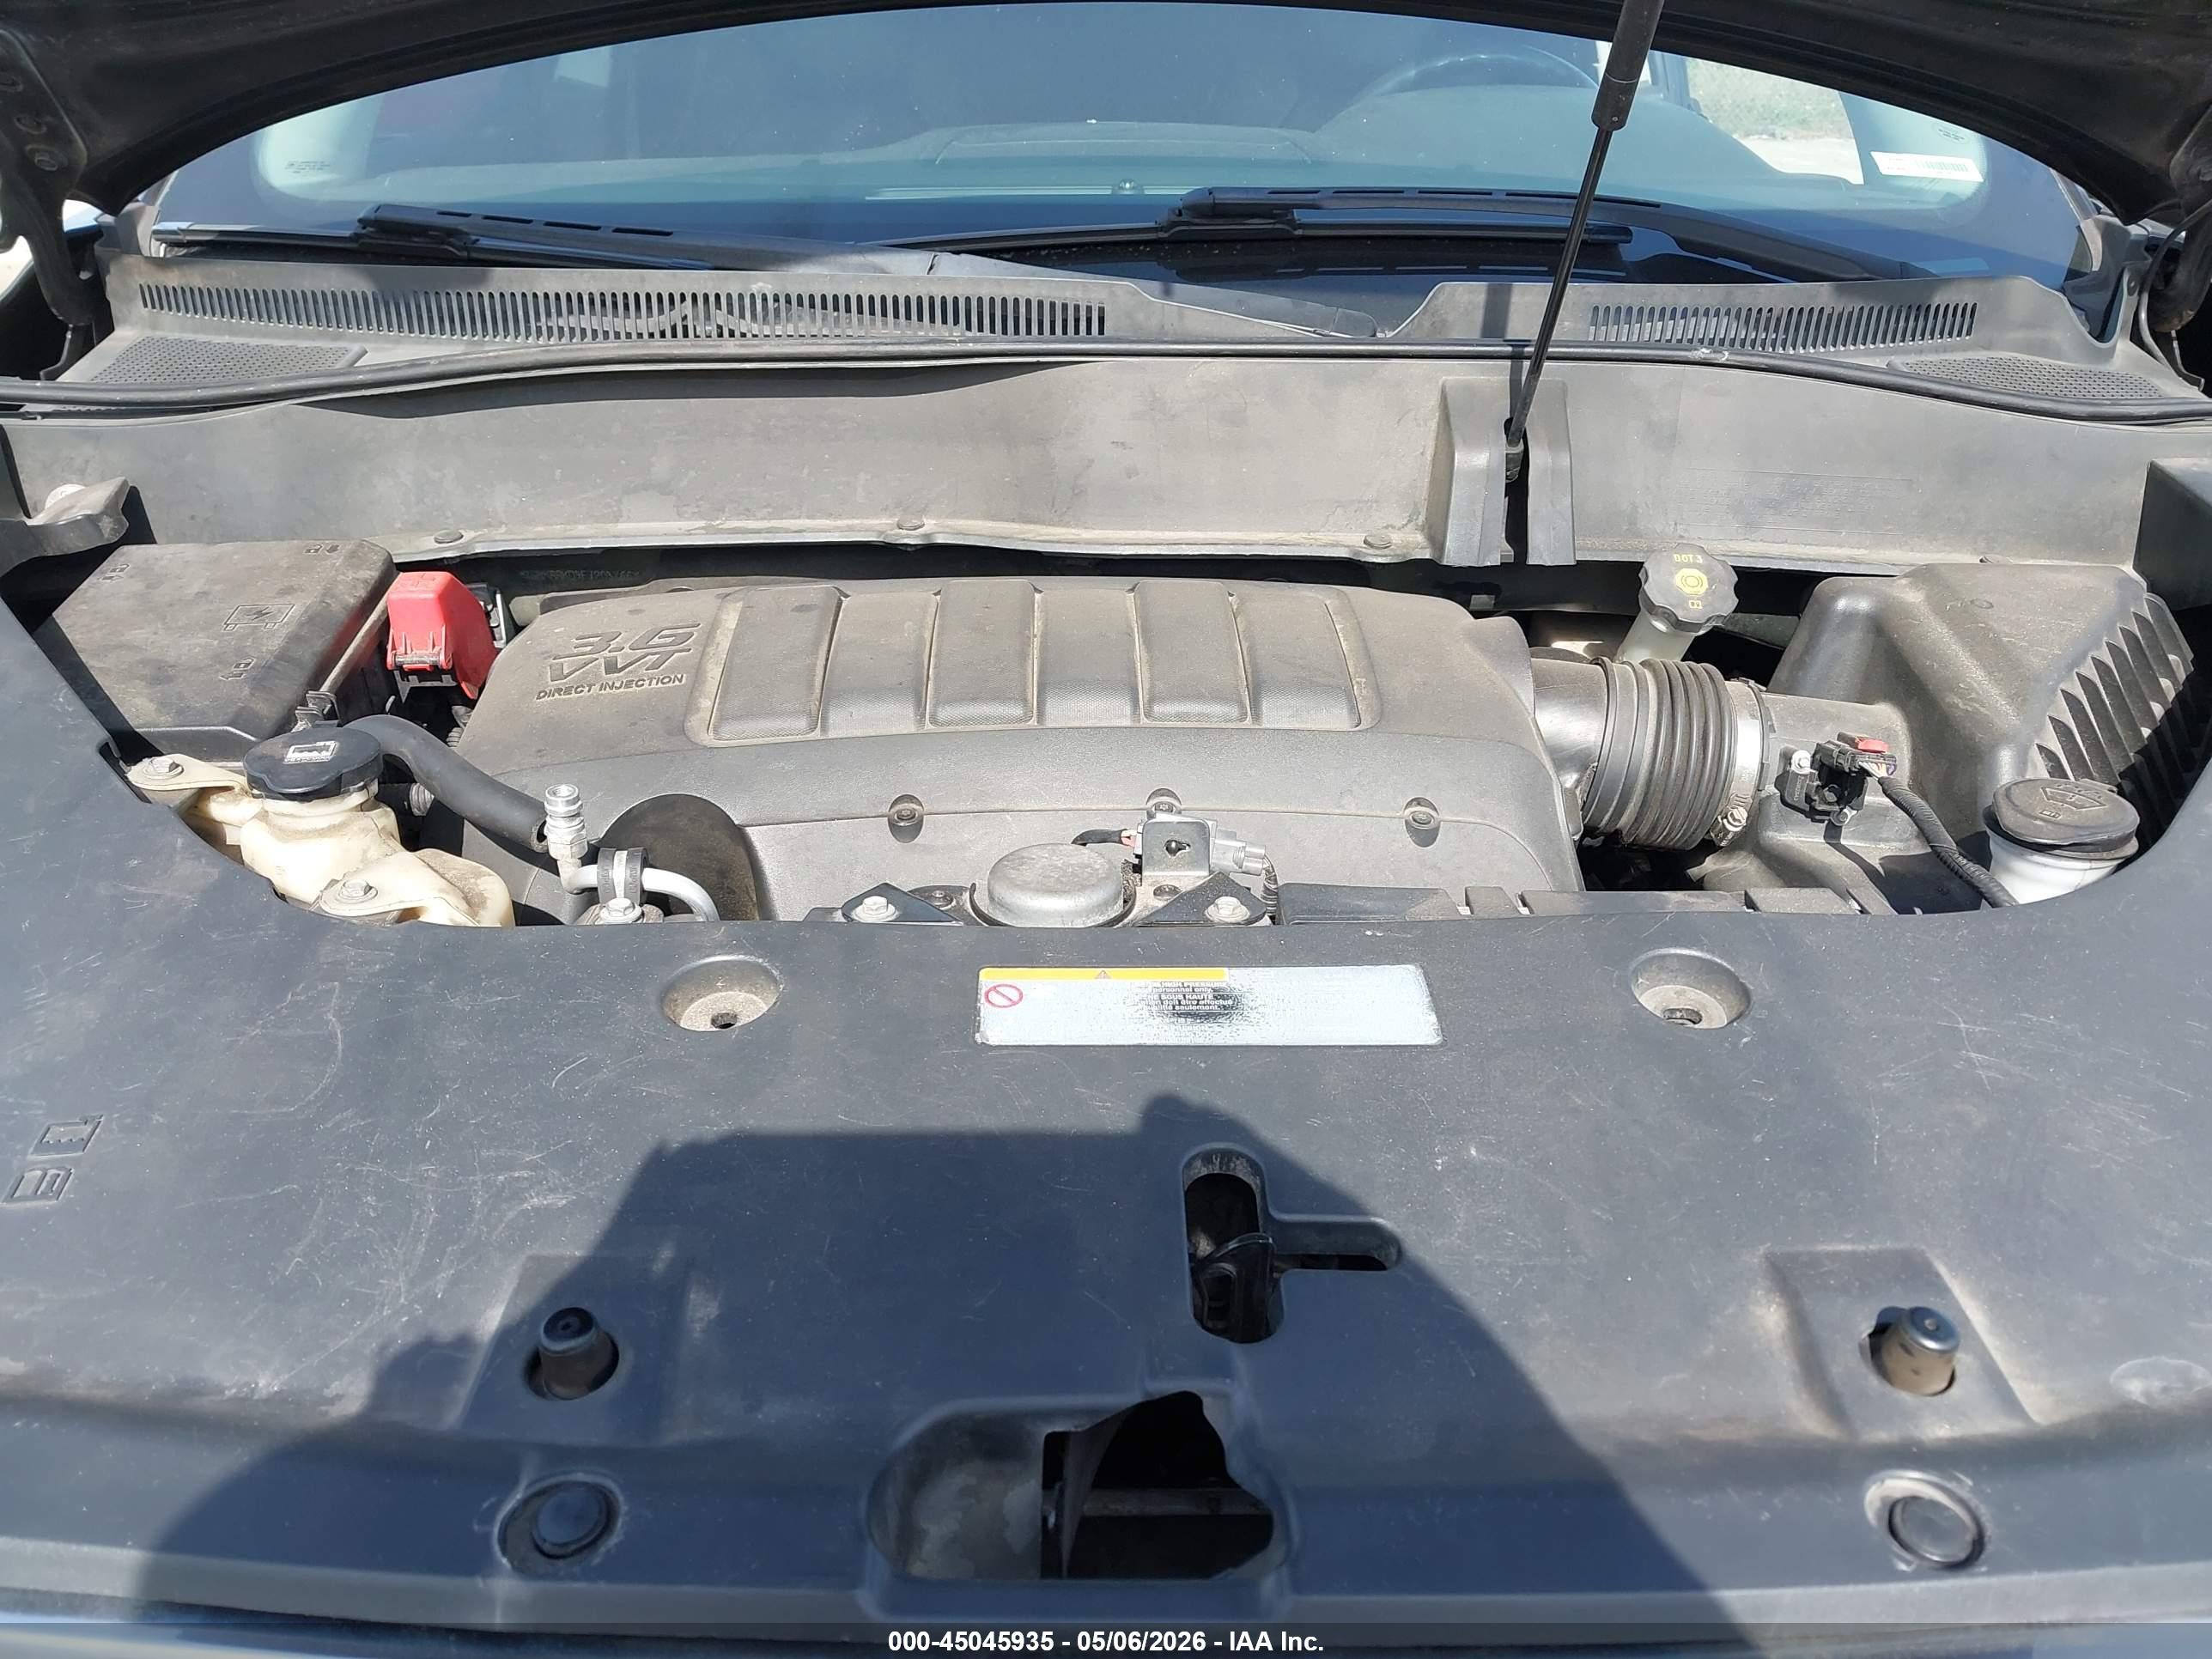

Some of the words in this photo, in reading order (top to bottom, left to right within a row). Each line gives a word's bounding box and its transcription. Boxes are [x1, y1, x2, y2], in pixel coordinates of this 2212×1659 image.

[1674, 554, 1694, 563] DOT
[1695, 555, 1704, 564] 3
[552, 623, 702, 660] 3.6
[549, 647, 693, 682] VVT
[536, 683, 595, 701] DIRECT
[599, 674, 684, 691] INJECTION
